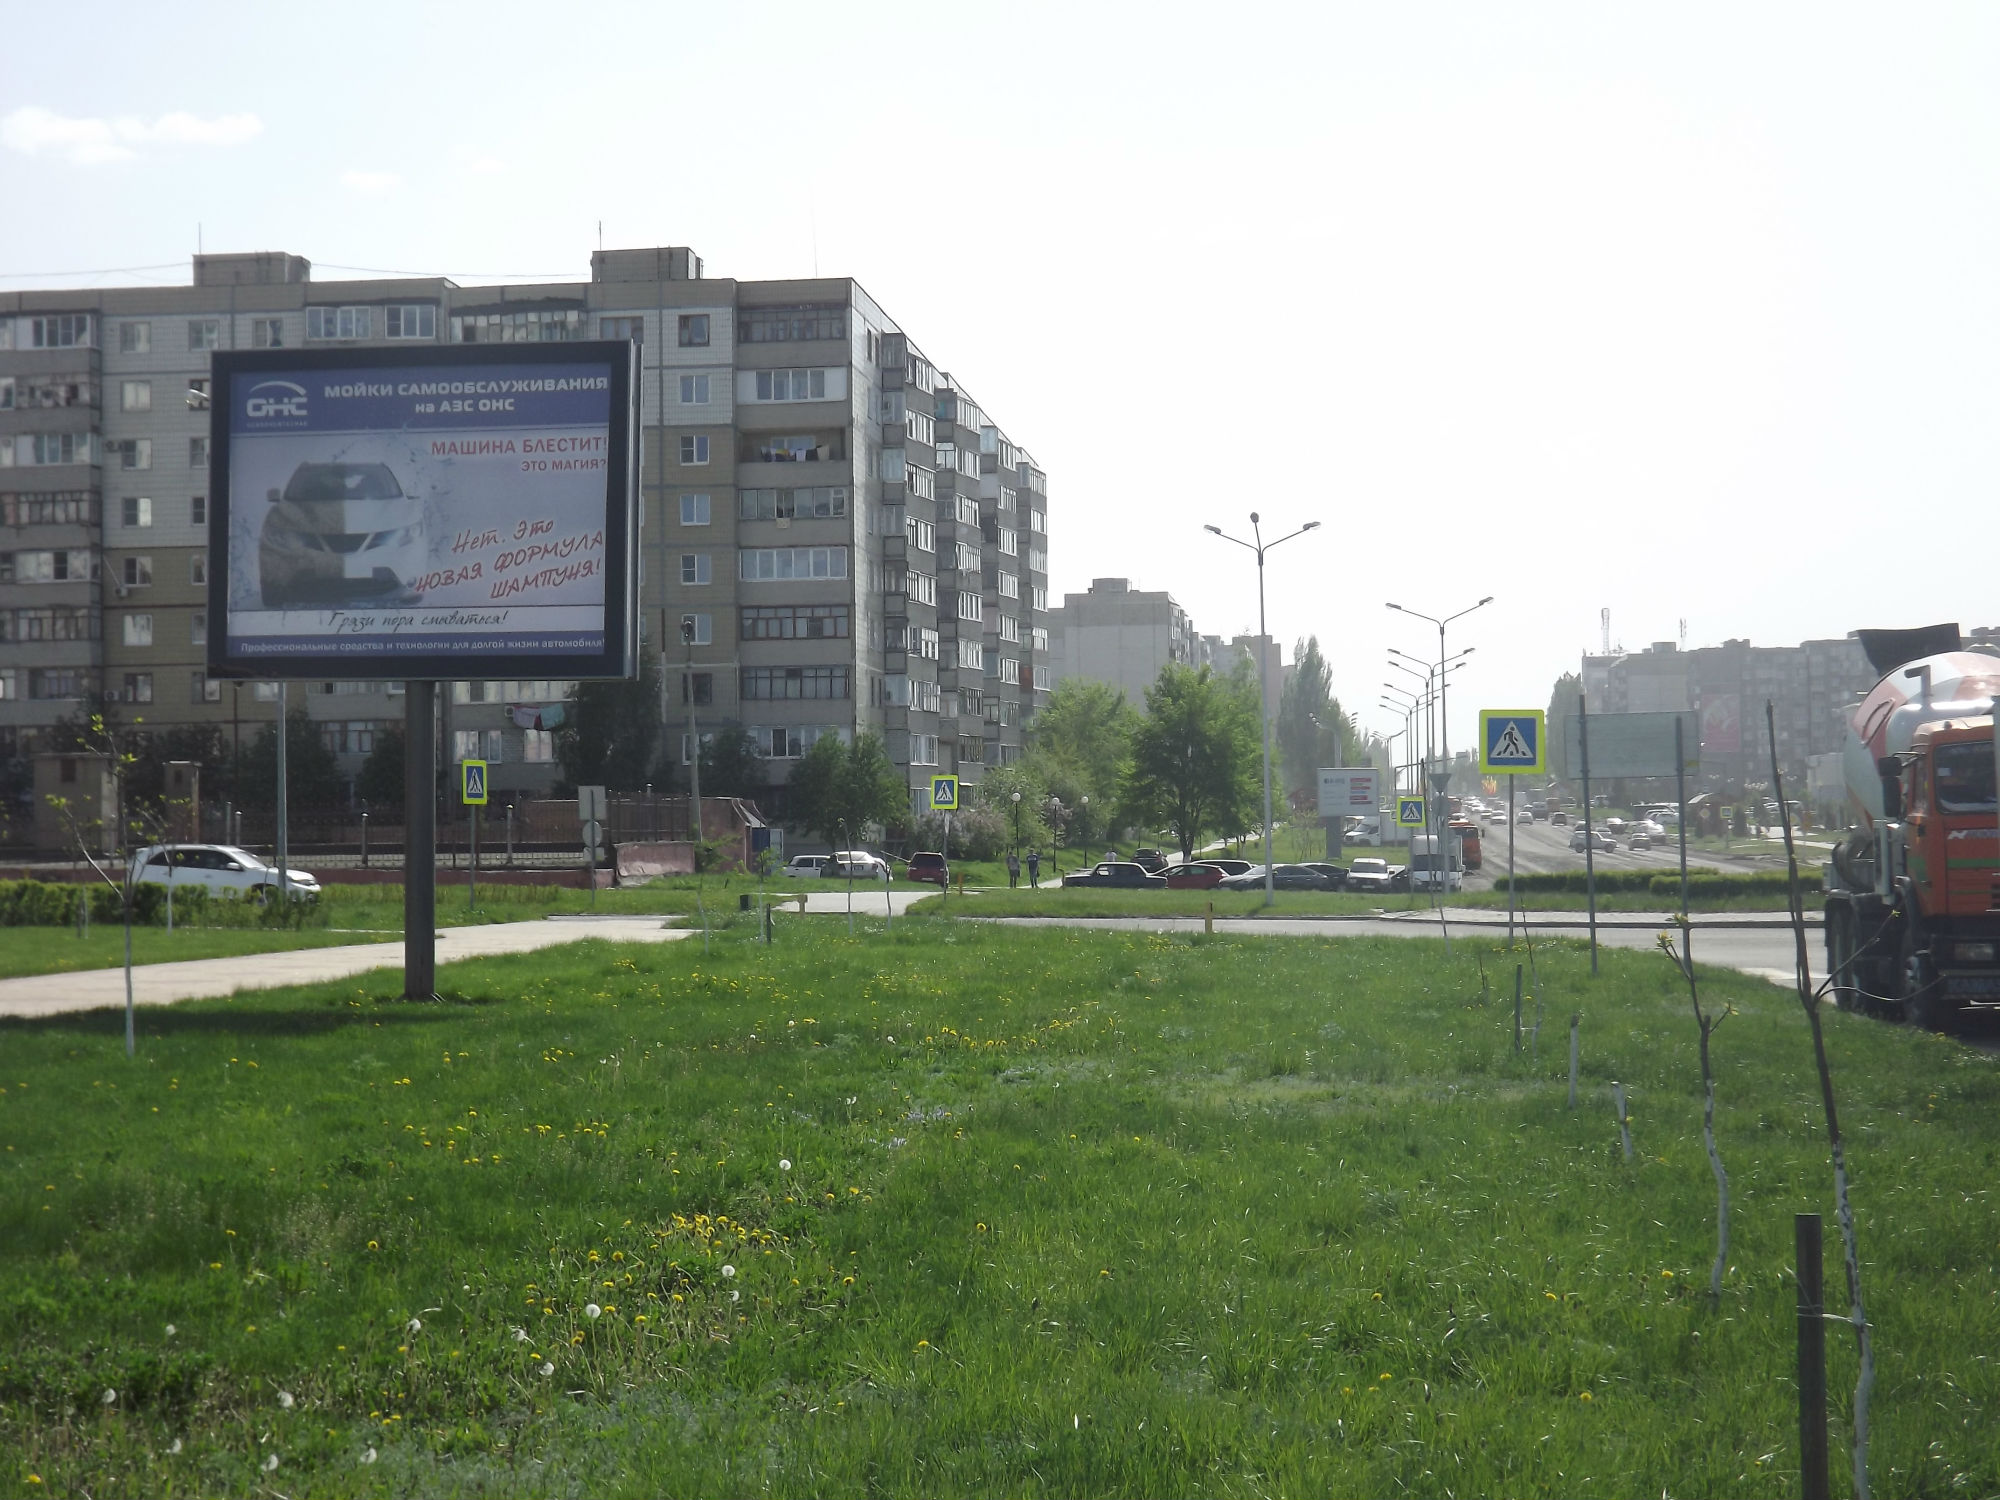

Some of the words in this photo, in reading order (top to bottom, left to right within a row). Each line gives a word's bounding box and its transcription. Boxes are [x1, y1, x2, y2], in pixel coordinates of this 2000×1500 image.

[324, 382, 392, 398] МОЙКИ
[397, 377, 608, 396] САМООБСЛУЖИВАНИЯ
[246, 397, 308, 417] ОНС
[415, 403, 435, 413] на
[440, 399, 473, 413] АЗС
[478, 398, 515, 411] ОНС
[431, 439, 516, 456] МАШИНА
[523, 437, 607, 454] БЛЕСТИТ!
[521, 460, 547, 472] ЭТО
[552, 458, 606, 471] МАГИЯ?
[452, 529, 505, 552] Нет.
[513, 520, 554, 540] Это
[415, 562, 484, 592] НОВАЯ
[494, 530, 603, 572] ФОРМУЛА
[490, 558, 601, 599] ШАМПУНЯ!
[328, 612, 374, 633] Грязи
[382, 615, 414, 633] пора
[421, 610, 508, 625] смываться!
[241, 642, 337, 653] Профессиональные
[340, 642, 384, 651] средства
[396, 640, 450, 650] технологии
[452, 640, 469, 650] для
[471, 639, 505, 649] долгой
[508, 640, 539, 648] жизни
